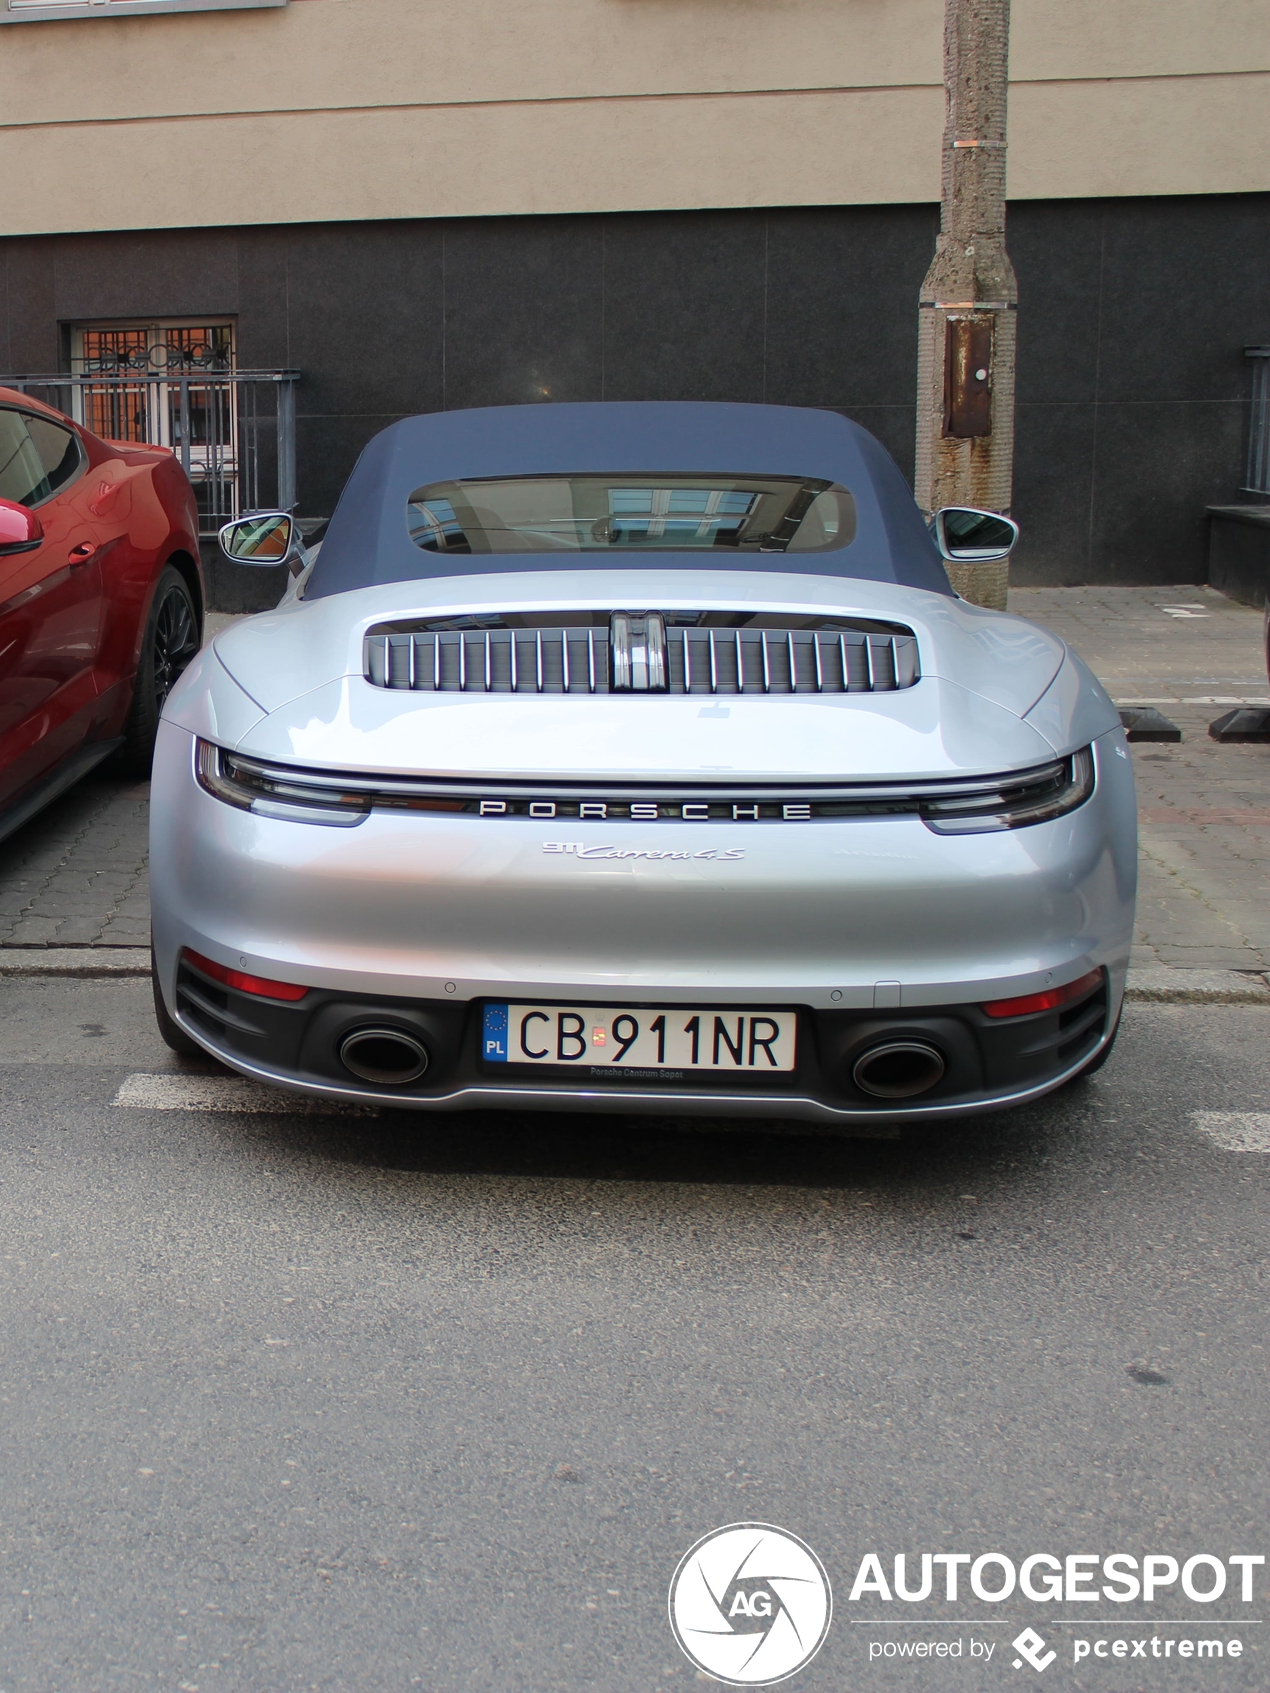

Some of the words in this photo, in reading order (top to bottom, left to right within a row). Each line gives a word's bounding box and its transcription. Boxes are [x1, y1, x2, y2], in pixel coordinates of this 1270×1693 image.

[479, 800, 812, 821] PORSCHE
[542, 841, 584, 854] 911
[577, 844, 691, 860] Carrera
[486, 1040, 505, 1055] PL
[519, 1010, 587, 1061] CB
[611, 1013, 780, 1068] 911NR
[590, 1066, 623, 1077] Porsche
[623, 1068, 659, 1078] Centrum
[659, 1069, 684, 1080] Sopot
